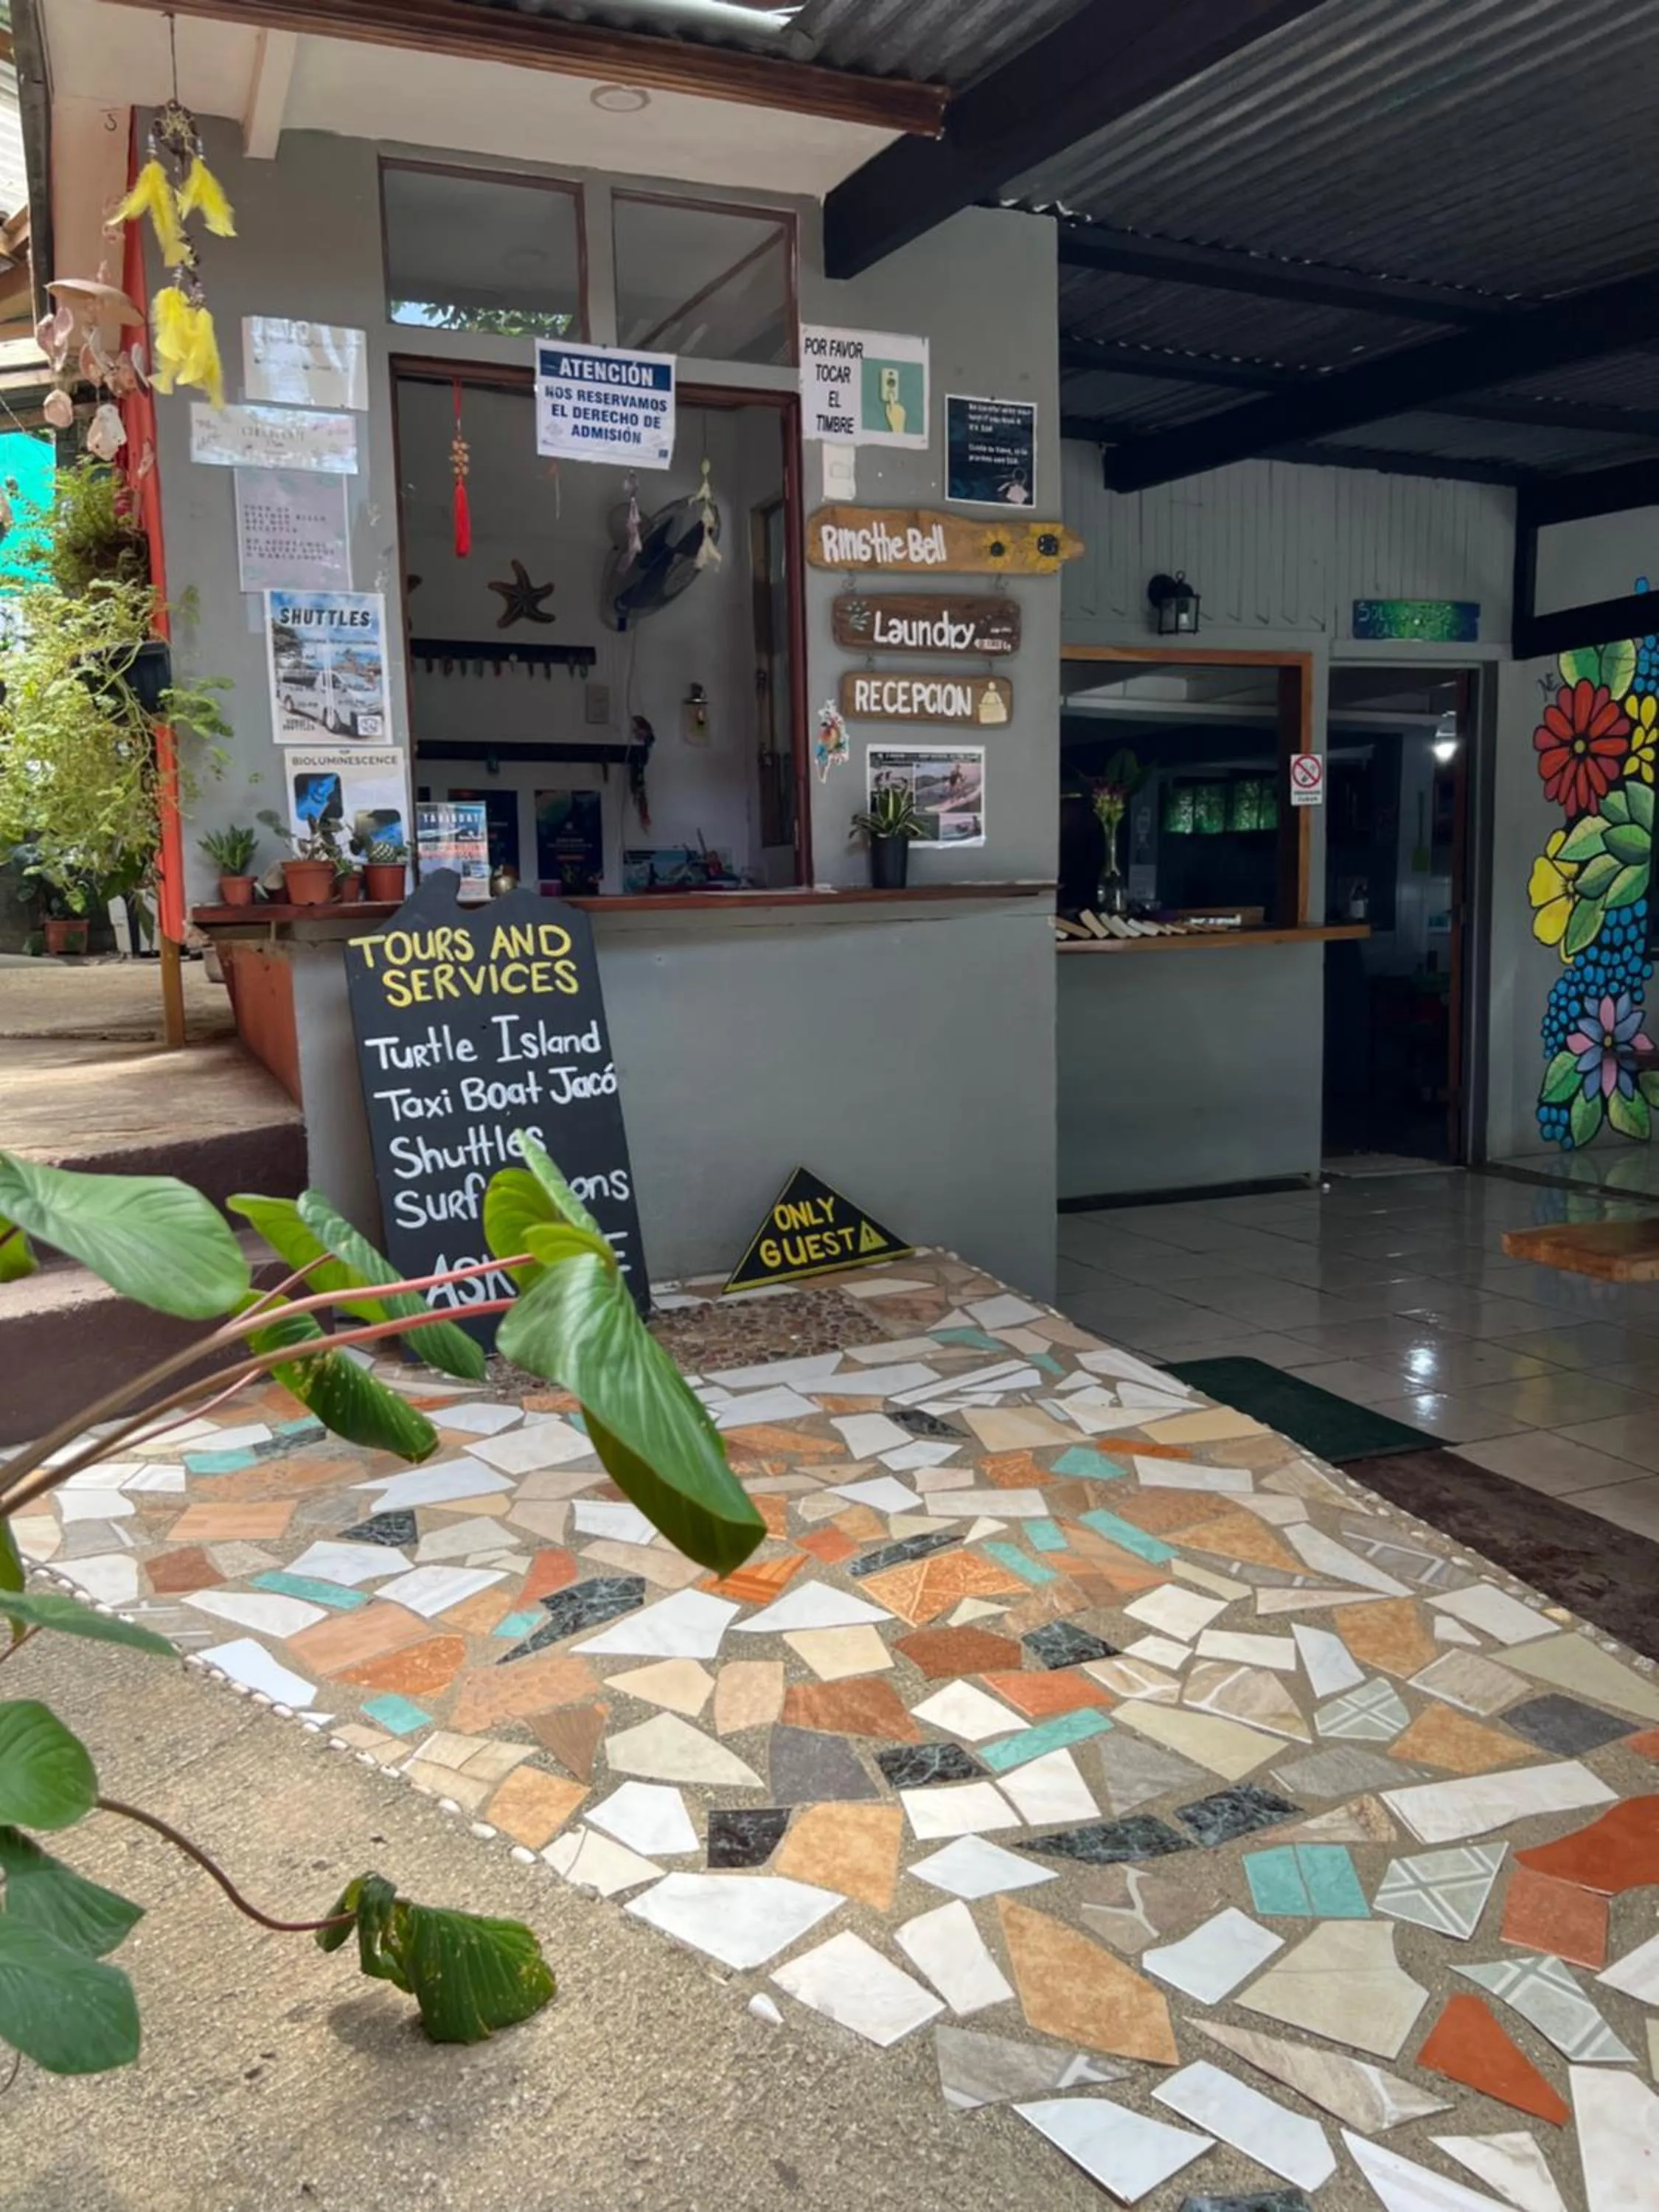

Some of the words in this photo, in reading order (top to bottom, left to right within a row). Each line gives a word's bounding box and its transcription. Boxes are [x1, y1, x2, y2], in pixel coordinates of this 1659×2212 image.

[804, 338, 827, 356] POR
[830, 340, 864, 360] FAVOR
[559, 357, 654, 387] ATENCIÓN
[815, 364, 851, 383] TOCAR
[545, 386, 573, 400] NOS
[577, 389, 667, 412] RESERVAMOS
[828, 391, 841, 408] EL
[551, 403, 568, 418] EL
[572, 406, 639, 426] DERECHO
[644, 415, 661, 430] DE
[815, 414, 855, 434] TIMBRE
[571, 423, 642, 444] ADMISIÓN
[906, 523, 947, 566] Bell
[279, 607, 372, 627] SHUTTLES
[873, 610, 976, 650] Laundry
[855, 679, 973, 717] RECEPCION
[291, 754, 399, 767] BIOLUMINESCENCE
[348, 926, 475, 968] TOURS
[490, 923, 572, 960] AND
[382, 960, 580, 1009] SERVICES
[491, 1015, 602, 1063] Island
[373, 1088, 453, 1122] Taxi
[460, 1071, 543, 1113] Boat
[549, 1062, 618, 1105] Jacó
[389, 1124, 547, 1180] Shuttles
[774, 1196, 835, 1232] ONLY
[759, 1227, 855, 1269] GUEST
